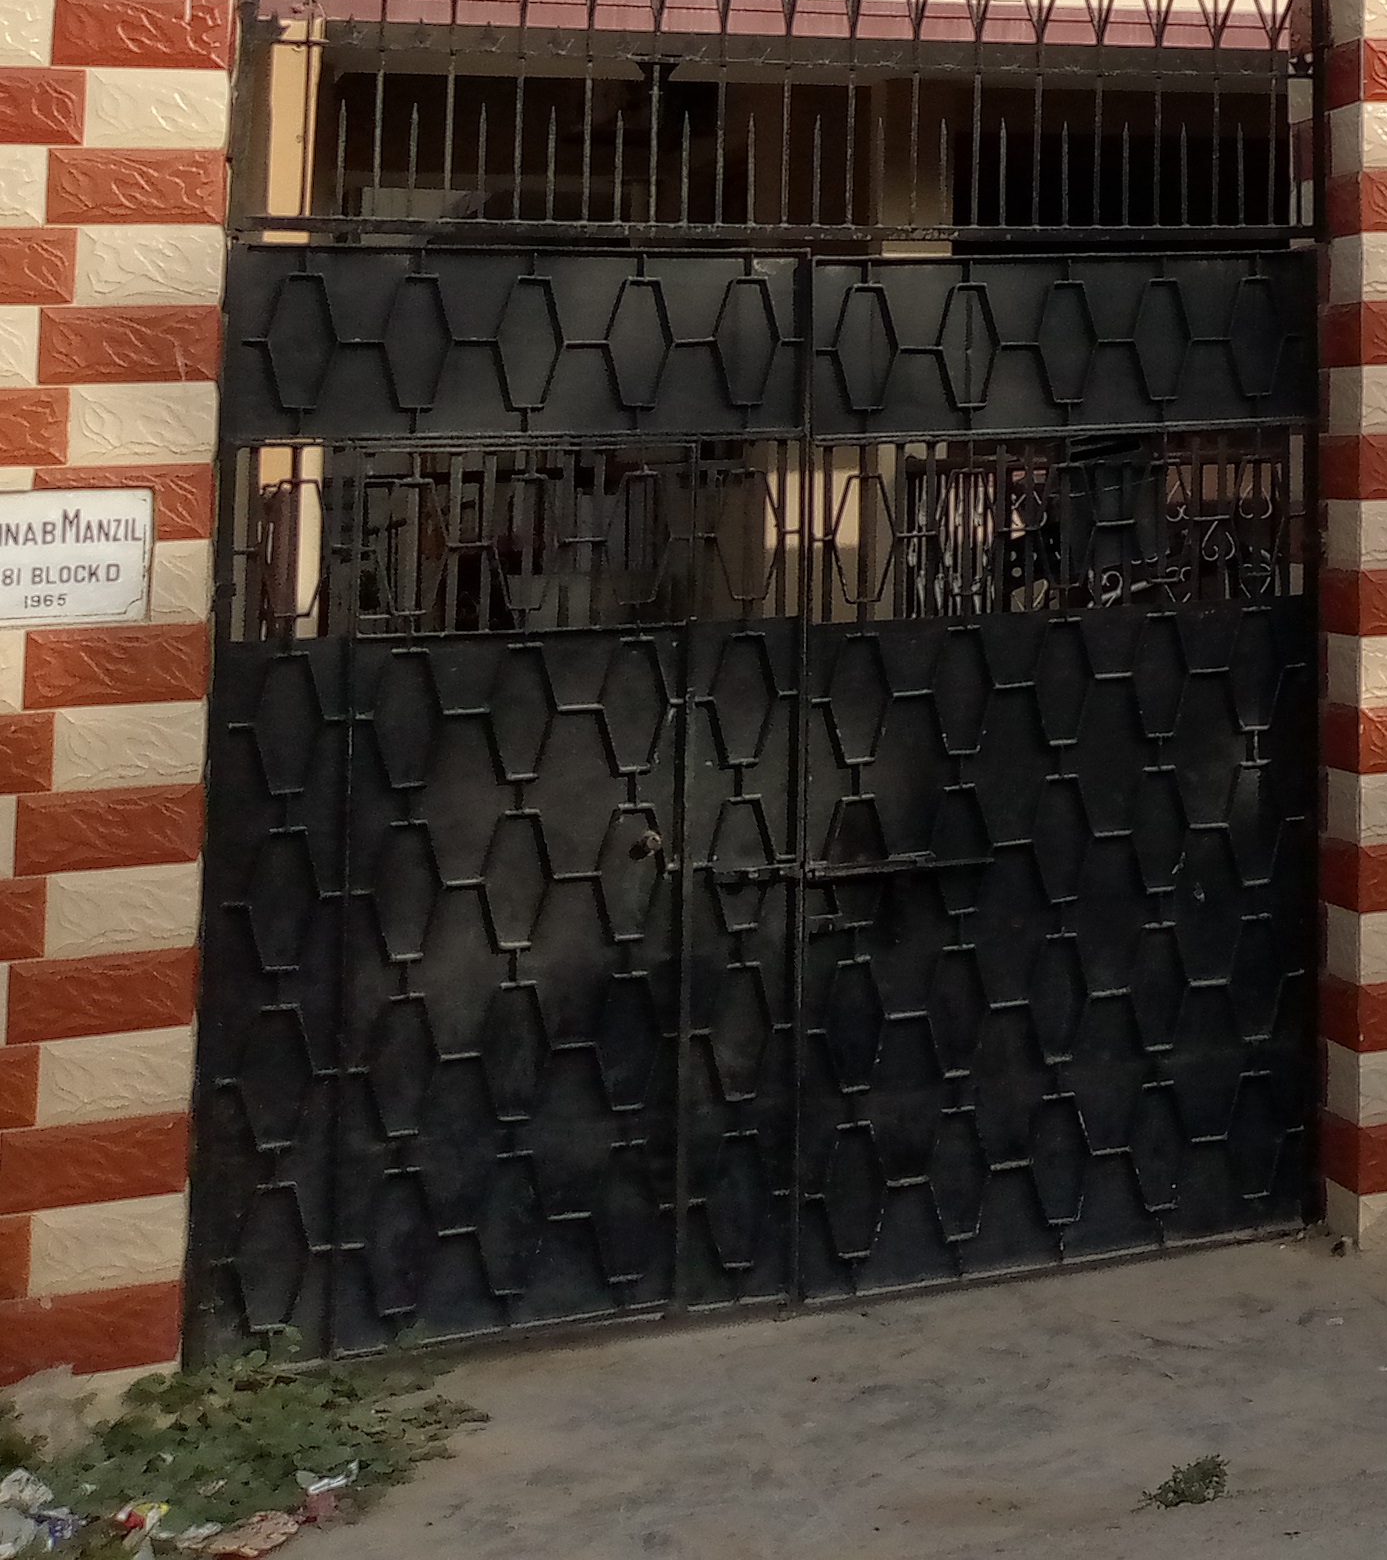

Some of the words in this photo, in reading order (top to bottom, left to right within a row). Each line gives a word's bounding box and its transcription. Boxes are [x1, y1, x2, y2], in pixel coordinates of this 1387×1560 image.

[61, 508, 142, 544] MANZIL
[2, 567, 21, 586] 81
[31, 564, 100, 586] BLOCK
[106, 563, 121, 582] D
[24, 593, 68, 609] 1965
